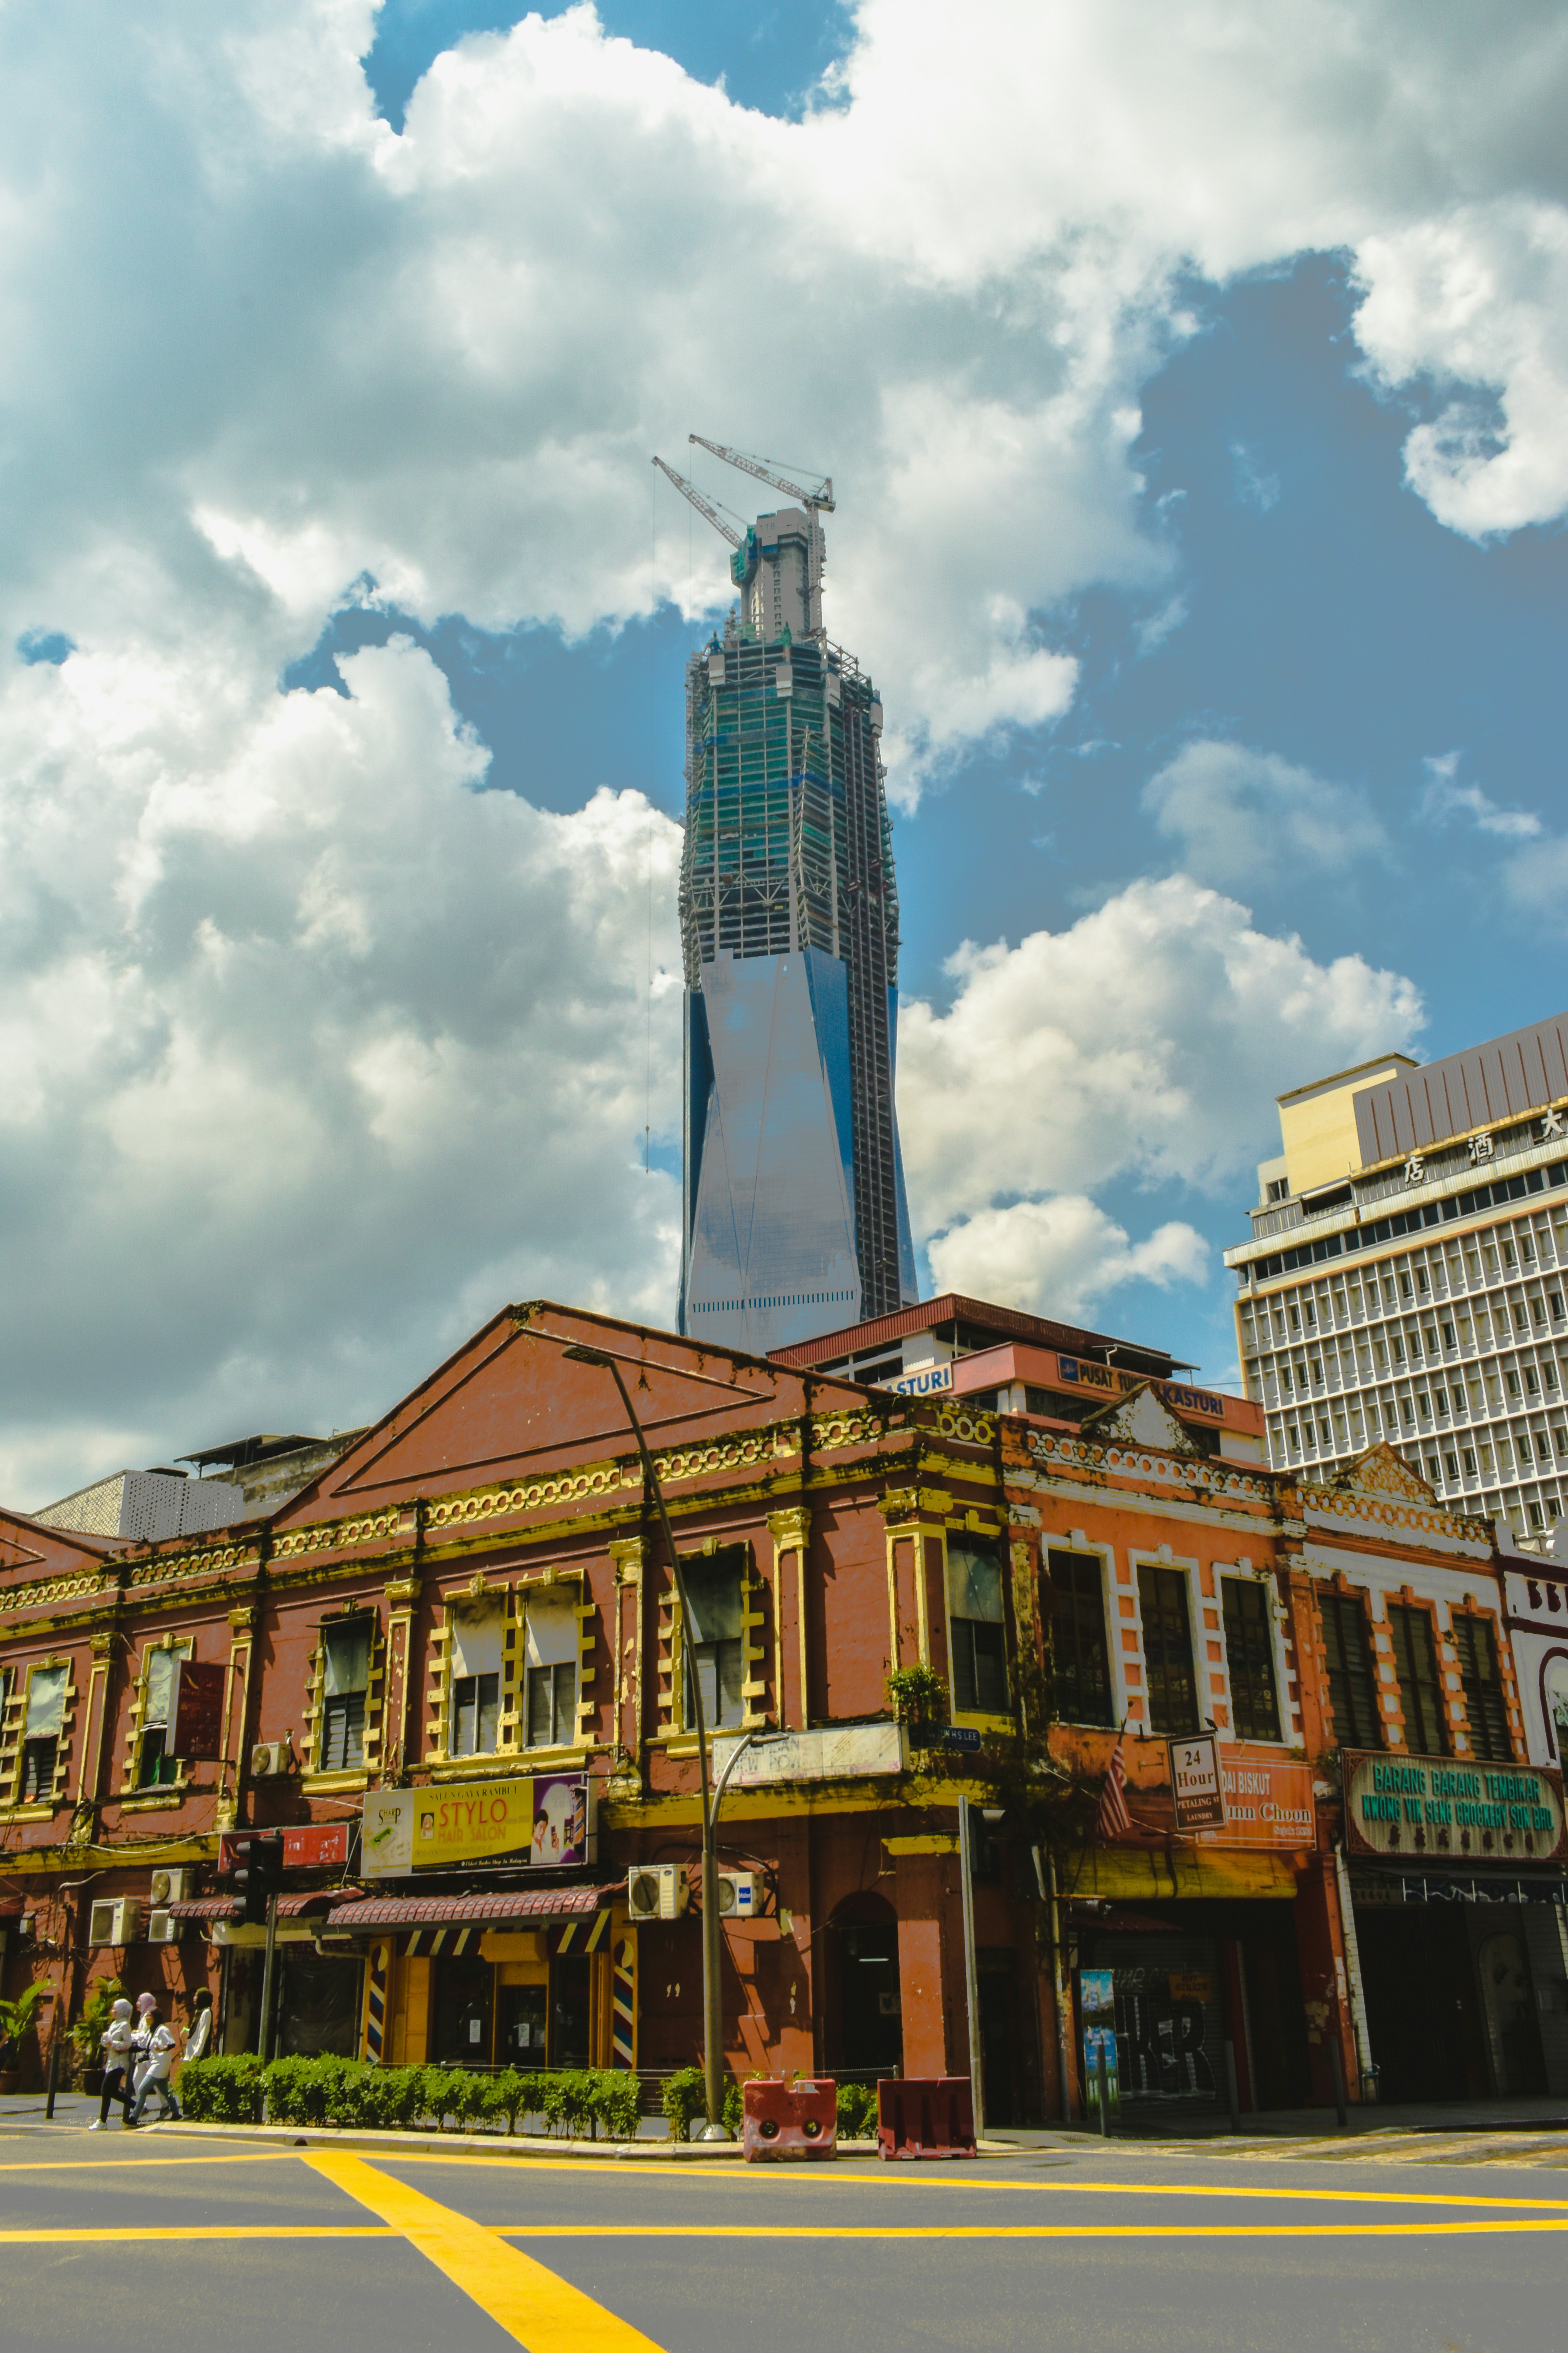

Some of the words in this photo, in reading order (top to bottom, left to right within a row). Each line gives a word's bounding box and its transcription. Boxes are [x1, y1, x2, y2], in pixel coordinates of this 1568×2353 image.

[760, 522, 775, 531] 118
[1080, 1364, 1113, 1388] PUSAT
[1163, 1385, 1224, 1415] KASTURI
[964, 1731, 978, 1741] LEE
[1185, 1749, 1201, 1766] 24
[1177, 1771, 1213, 1787] Hour
[1221, 1770, 1236, 1793] DAI
[1238, 1772, 1270, 1795] BISKUT
[1373, 1764, 1427, 1795] BARANG
[1431, 1770, 1481, 1799] BARANG
[1485, 1773, 1540, 1803] TEMBIKAR
[482, 1786, 517, 1797] RAMBUT
[1177, 1797, 1211, 1809] PETALING
[1362, 1794, 1401, 1821] KWONG
[1404, 1797, 1423, 1824] YIK
[1426, 1800, 1453, 1824] SENG
[1456, 1801, 1506, 1827] CROCKERY
[378, 1808, 401, 1826] SHARP
[439, 1798, 508, 1827] STYLO
[1187, 1812, 1213, 1821] LAUNDRY
[1259, 1802, 1312, 1823] Choon
[438, 1827, 464, 1844] HAIR
[470, 1825, 506, 1843] SALON
